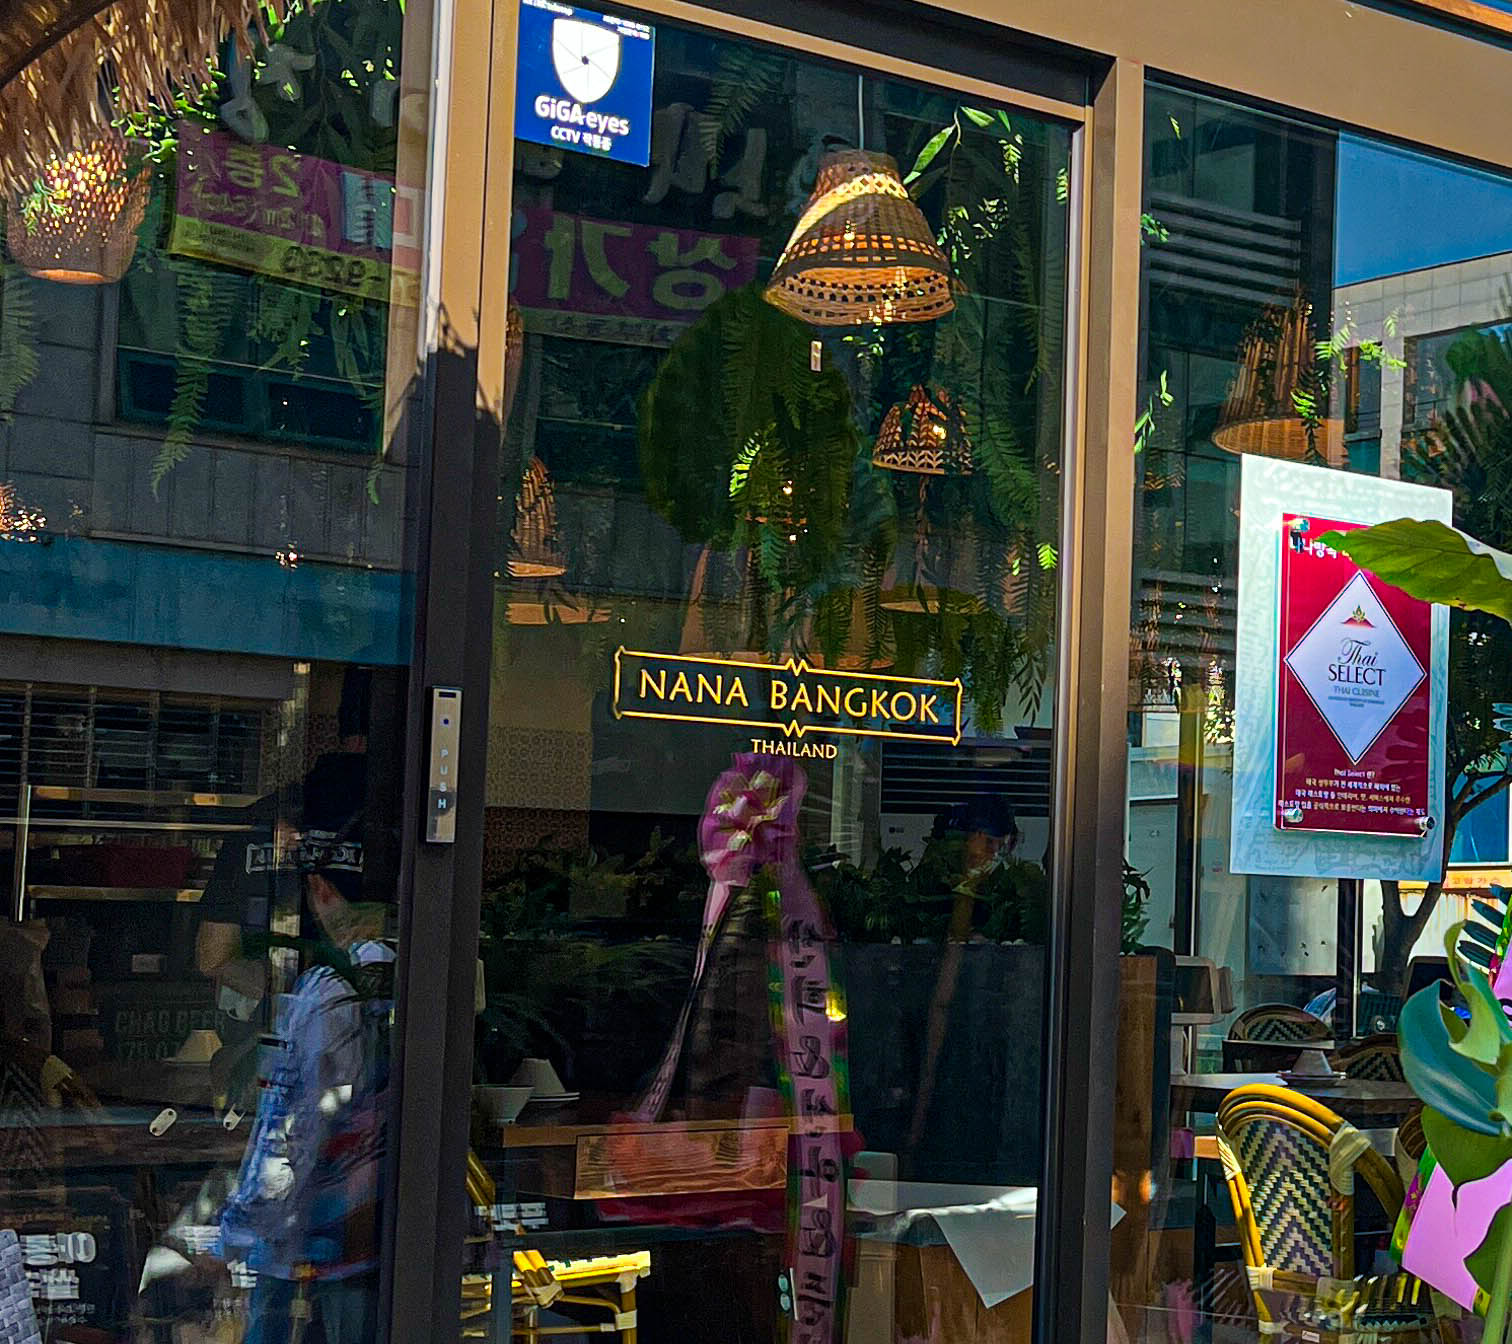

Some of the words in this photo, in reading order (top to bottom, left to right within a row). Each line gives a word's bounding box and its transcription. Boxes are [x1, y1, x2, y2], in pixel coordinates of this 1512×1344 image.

[550, 125, 581, 145] CCTV
[1337, 636, 1379, 666] Thai
[1327, 663, 1387, 687] SELECT
[639, 669, 749, 708] NANA
[770, 680, 939, 724] BANGKOK
[750, 739, 839, 760] THAILAND
